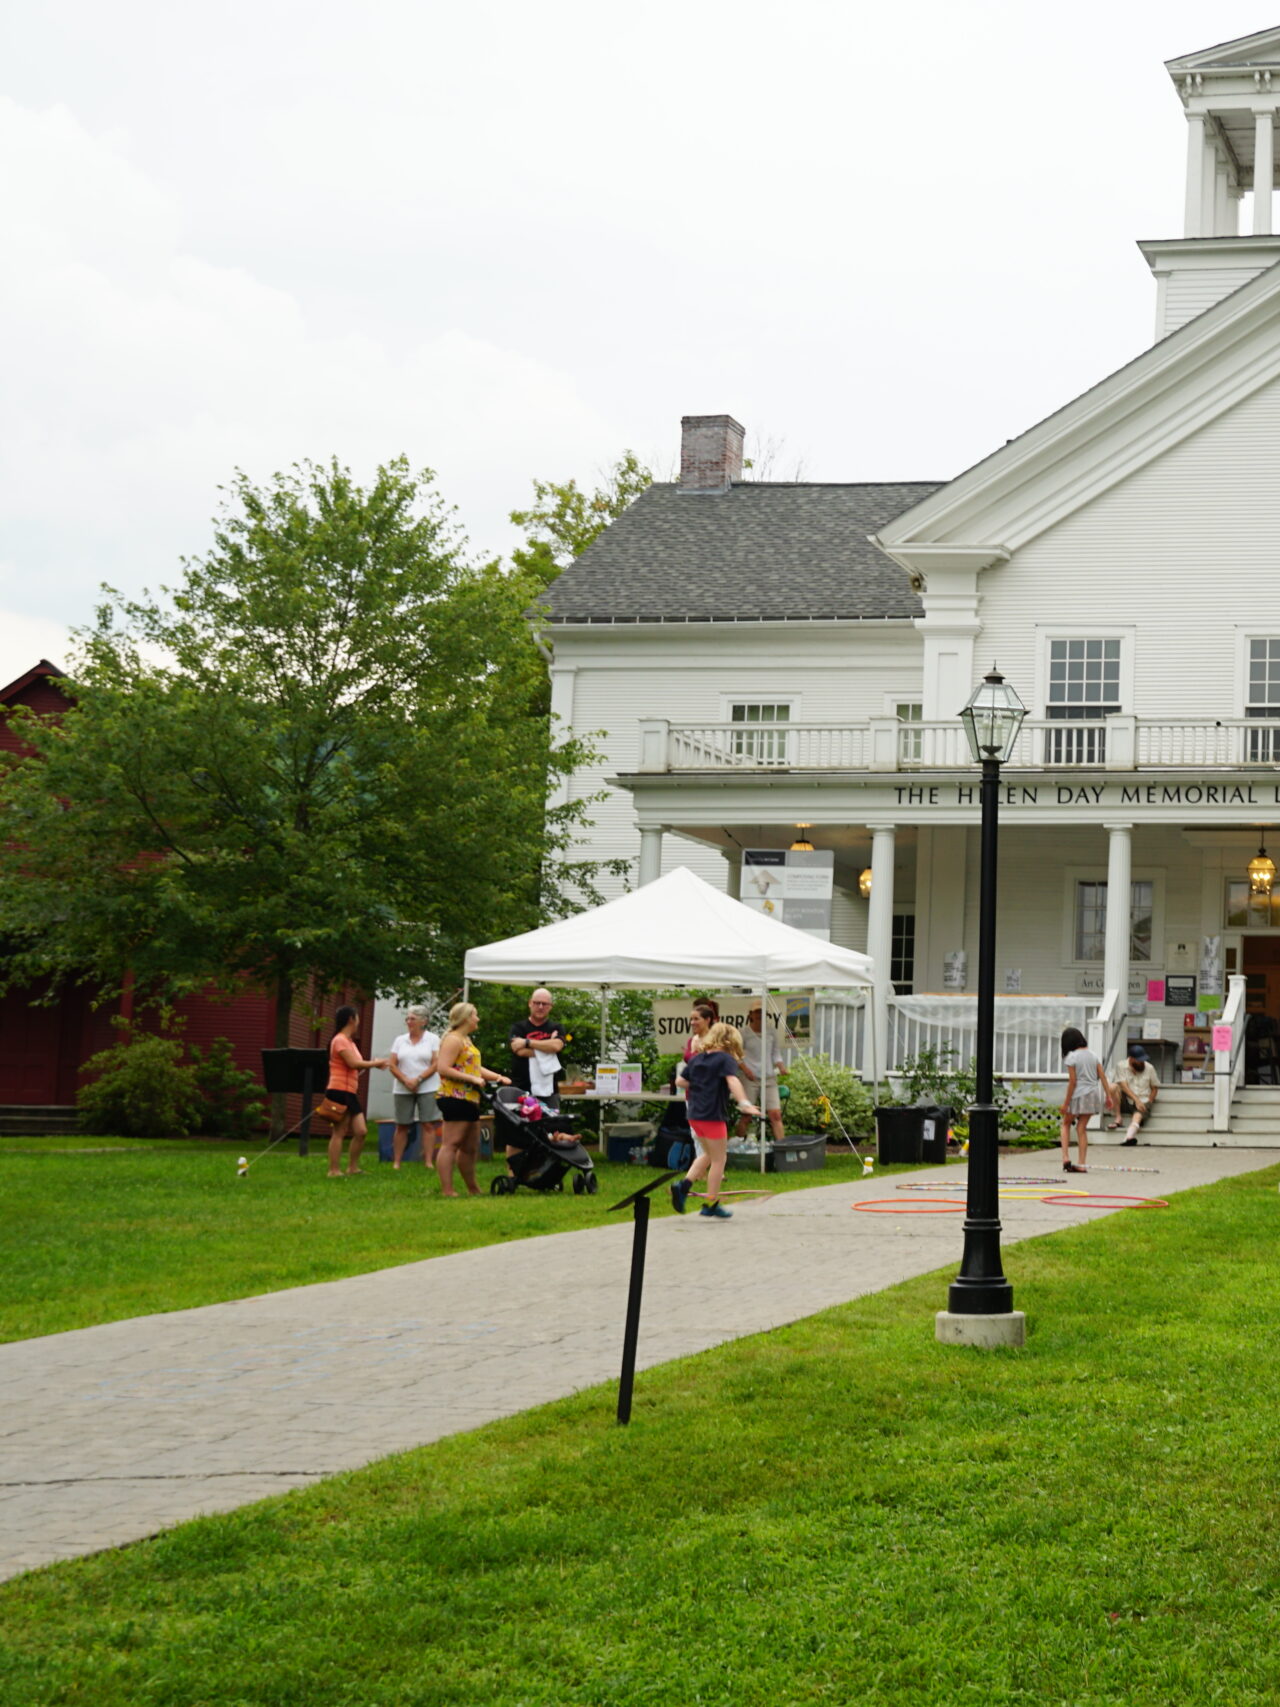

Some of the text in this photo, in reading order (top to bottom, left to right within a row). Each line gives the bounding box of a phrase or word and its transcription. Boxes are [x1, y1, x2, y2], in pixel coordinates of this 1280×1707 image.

[894, 786, 940, 805] THE
[957, 786, 1039, 805] HEN
[1056, 786, 1106, 805] DAY
[1119, 785, 1258, 804] MEMORIAL
